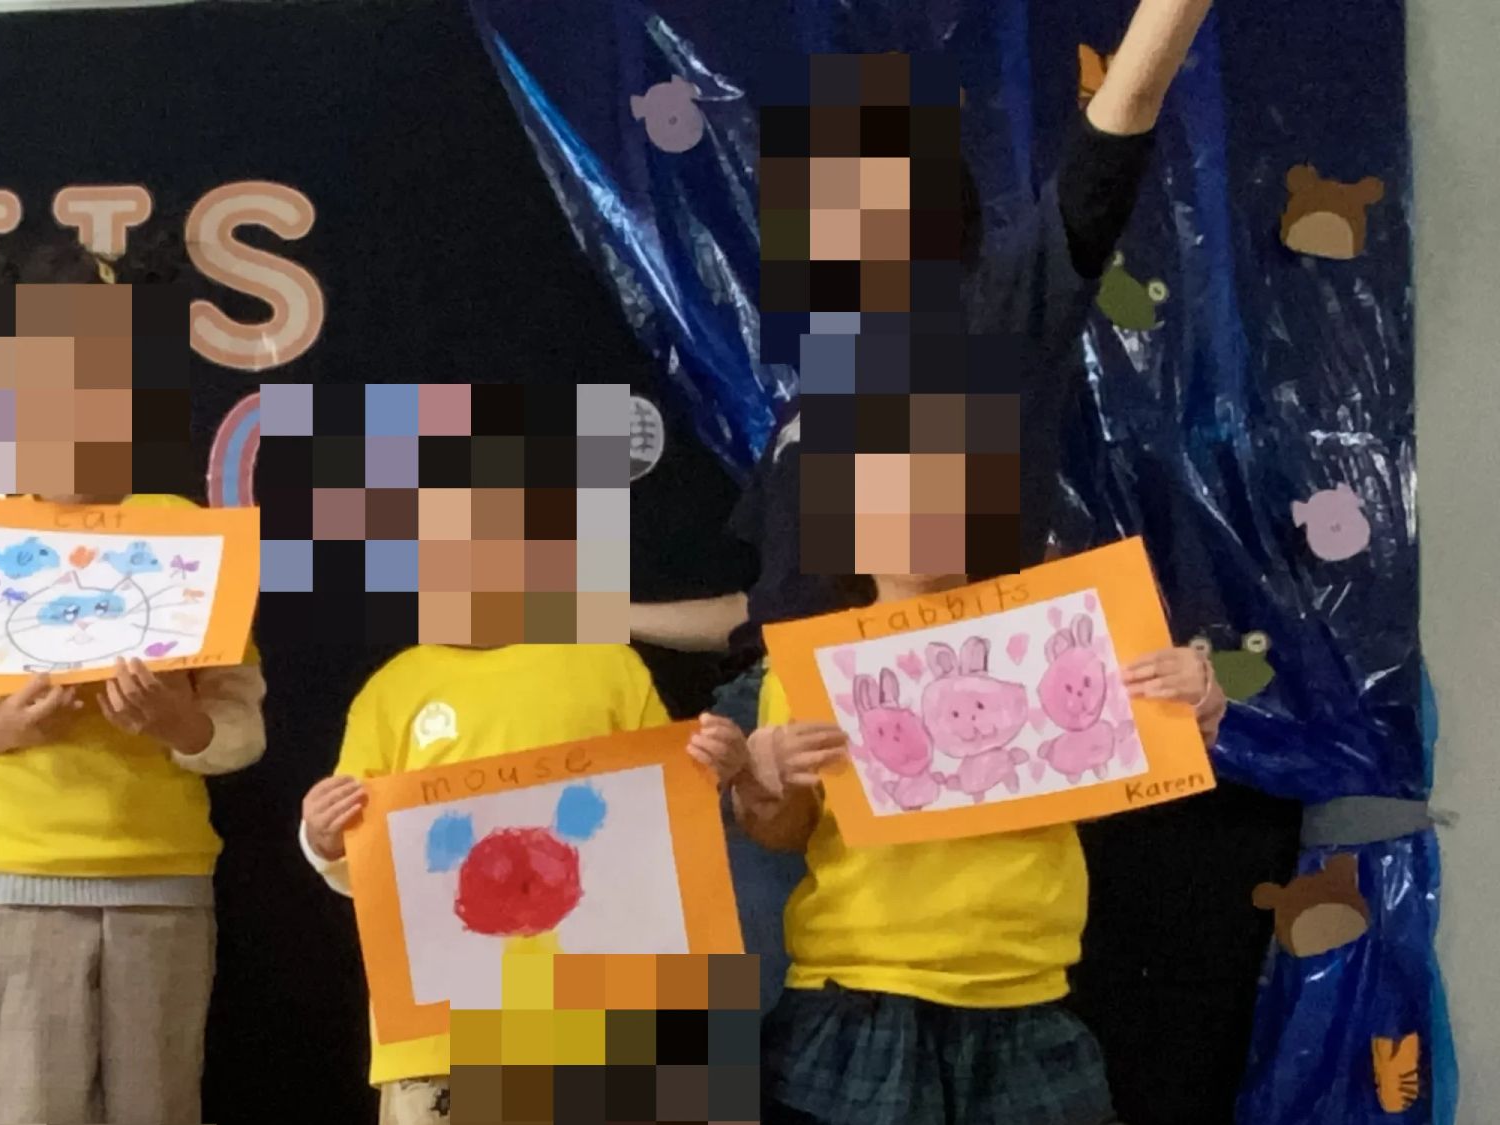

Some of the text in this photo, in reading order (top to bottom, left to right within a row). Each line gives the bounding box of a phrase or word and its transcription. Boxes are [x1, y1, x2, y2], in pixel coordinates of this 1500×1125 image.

[54, 508, 127, 529] cat
[856, 581, 1031, 639] rabbits
[421, 746, 593, 803] mouse
[1125, 772, 1205, 804] Karen
